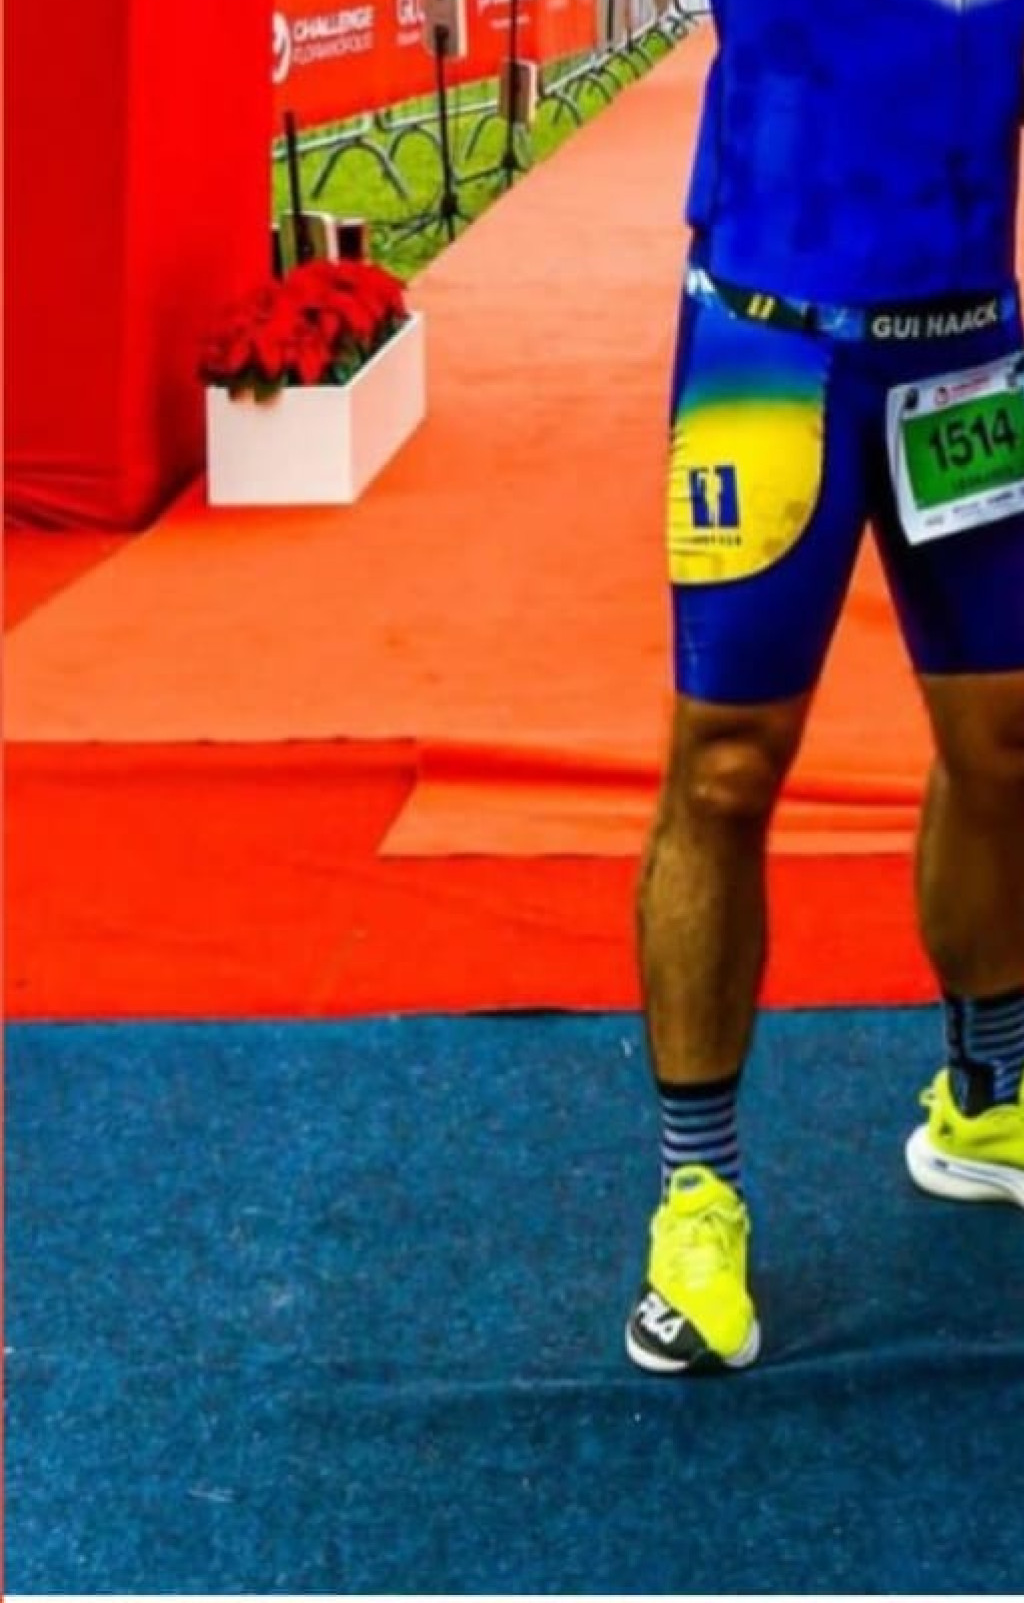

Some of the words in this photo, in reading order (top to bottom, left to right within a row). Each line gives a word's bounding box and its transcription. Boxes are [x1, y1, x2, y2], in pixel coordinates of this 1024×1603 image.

[872, 315, 920, 339] GUI
[926, 298, 997, 337] HAACK
[929, 408, 1018, 472] 1514
